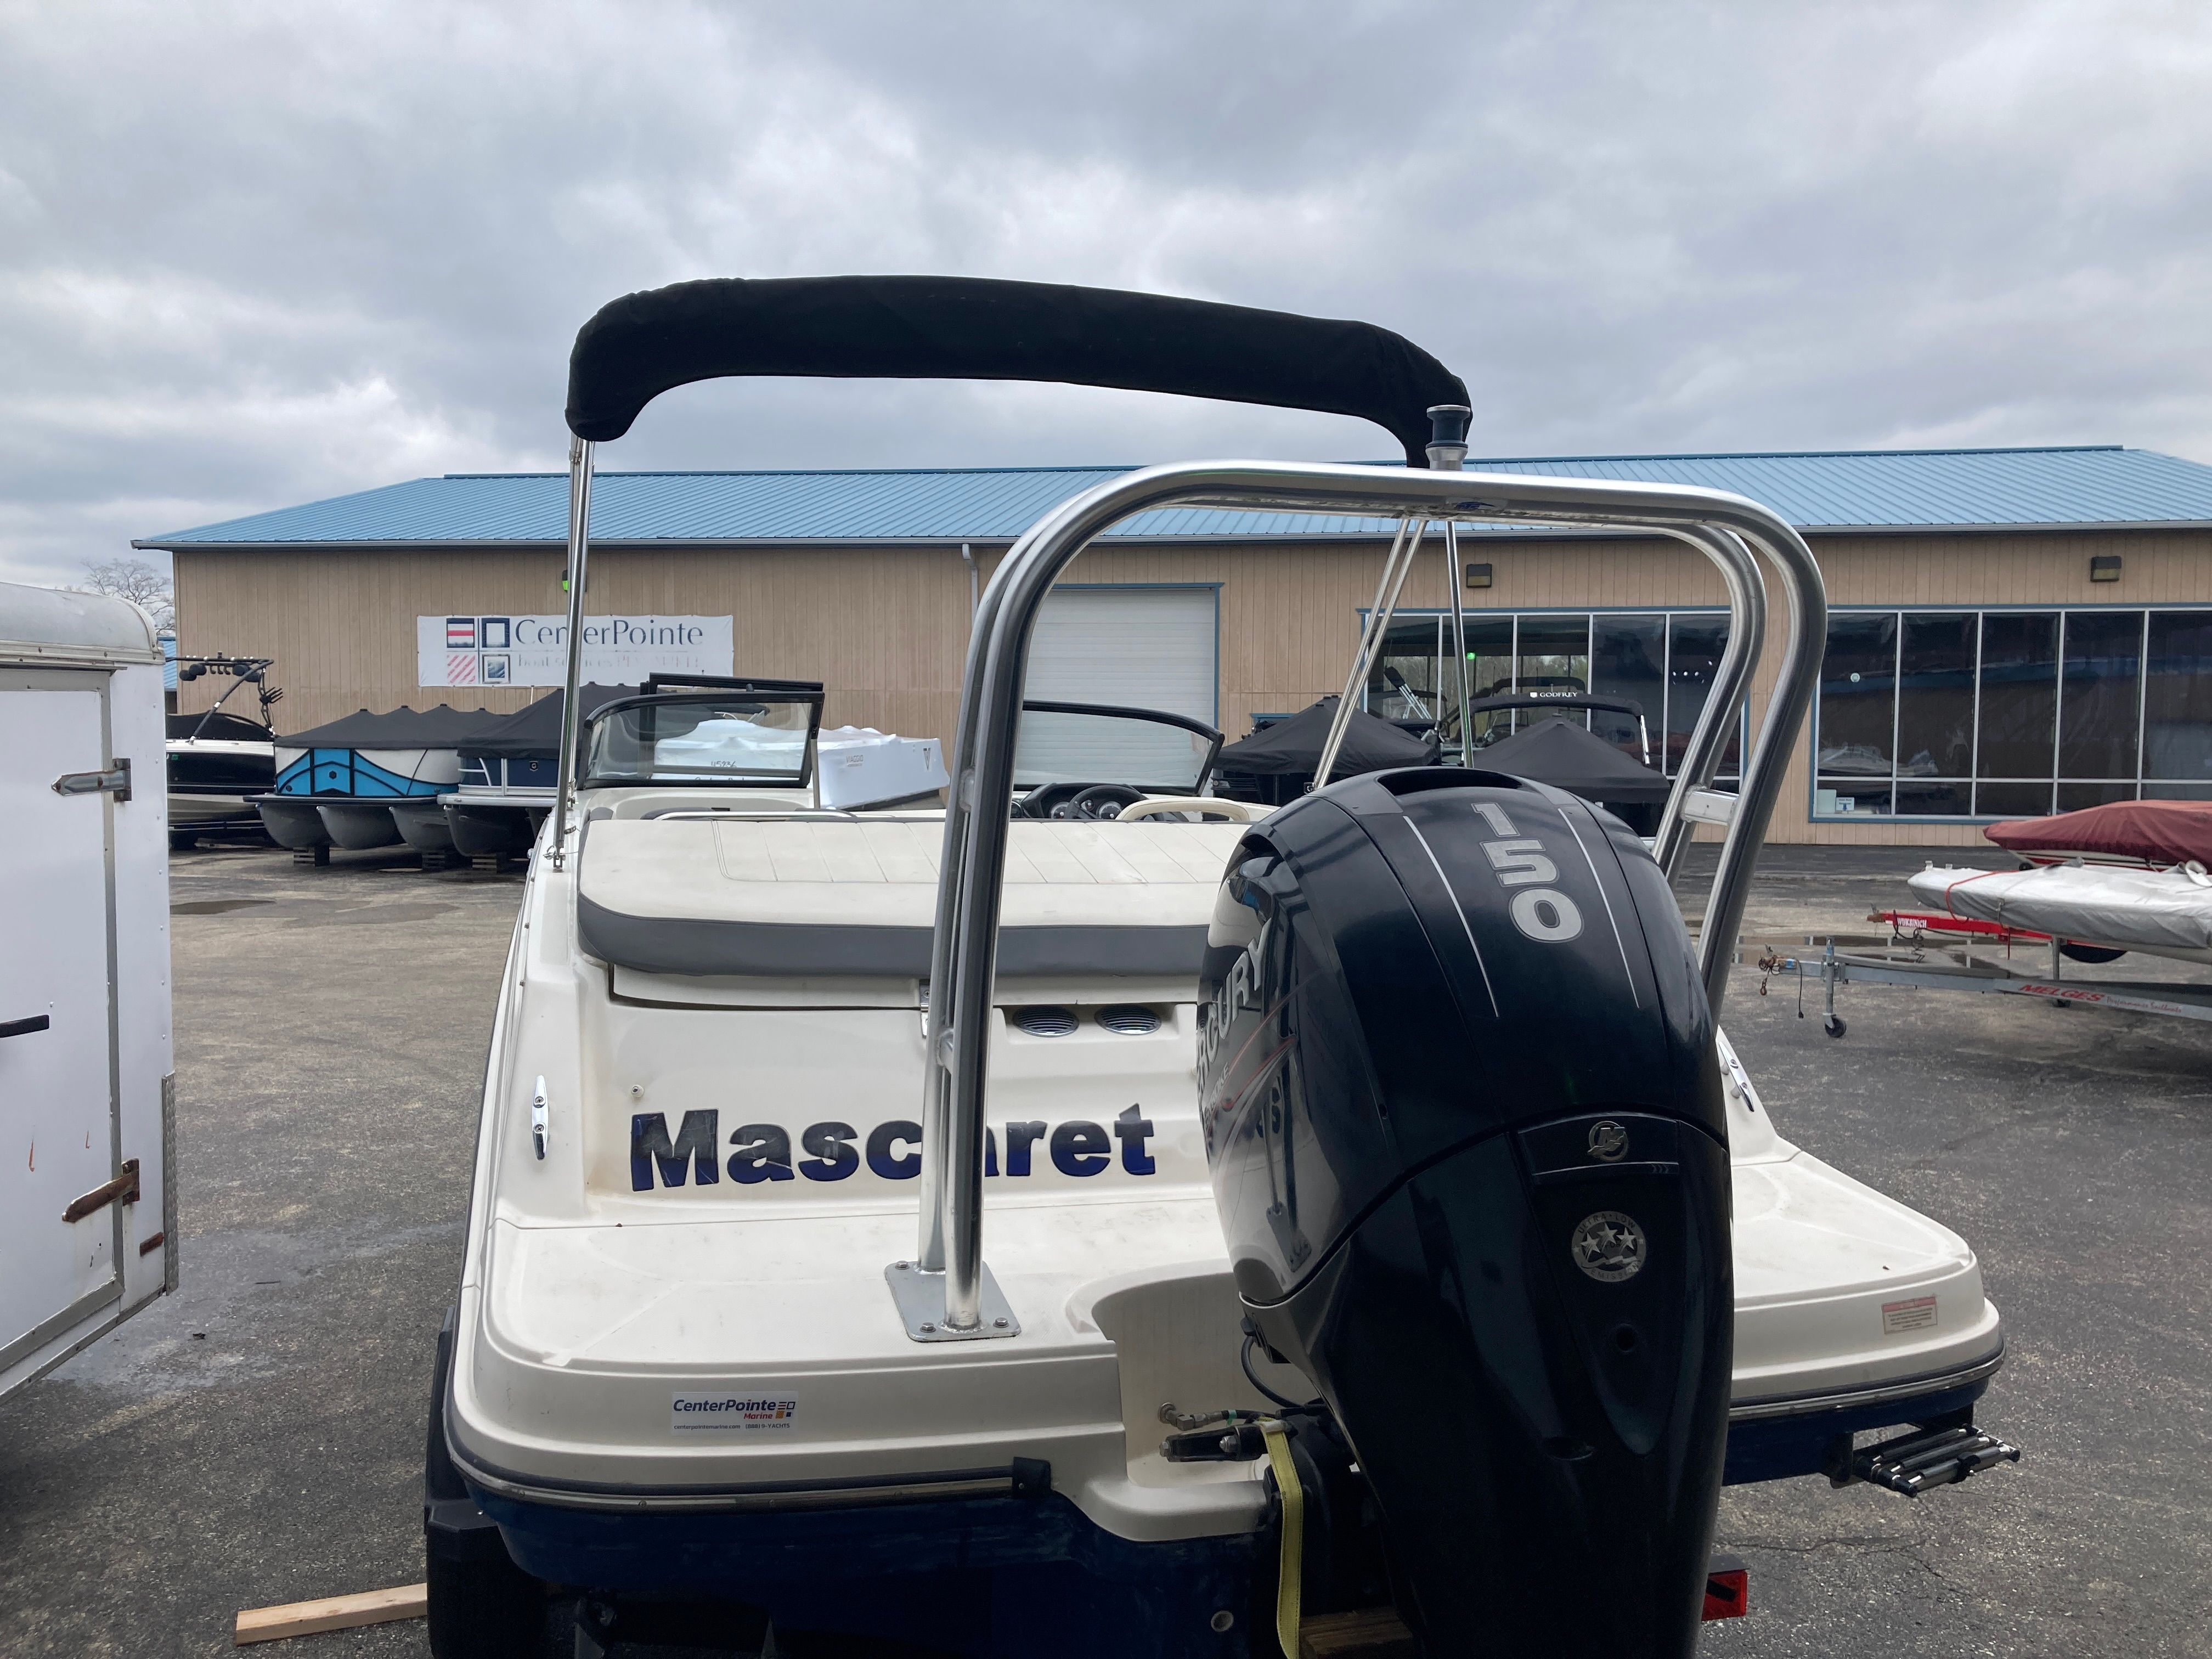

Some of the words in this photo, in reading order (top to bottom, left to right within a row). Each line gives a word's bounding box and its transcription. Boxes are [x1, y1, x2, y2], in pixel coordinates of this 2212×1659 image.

[515, 619, 703, 645] CenerPointe
[1471, 802, 1584, 943] 150
[2018, 984, 2105, 1001] MELGES
[1197, 917, 1271, 1100] RCURY
[631, 1103, 1156, 1192] Mascret
[1578, 1212, 1607, 1234] ULTRA
[1590, 1262, 1639, 1280] EMISSION
[673, 1399, 776, 1412] CenterPointe
